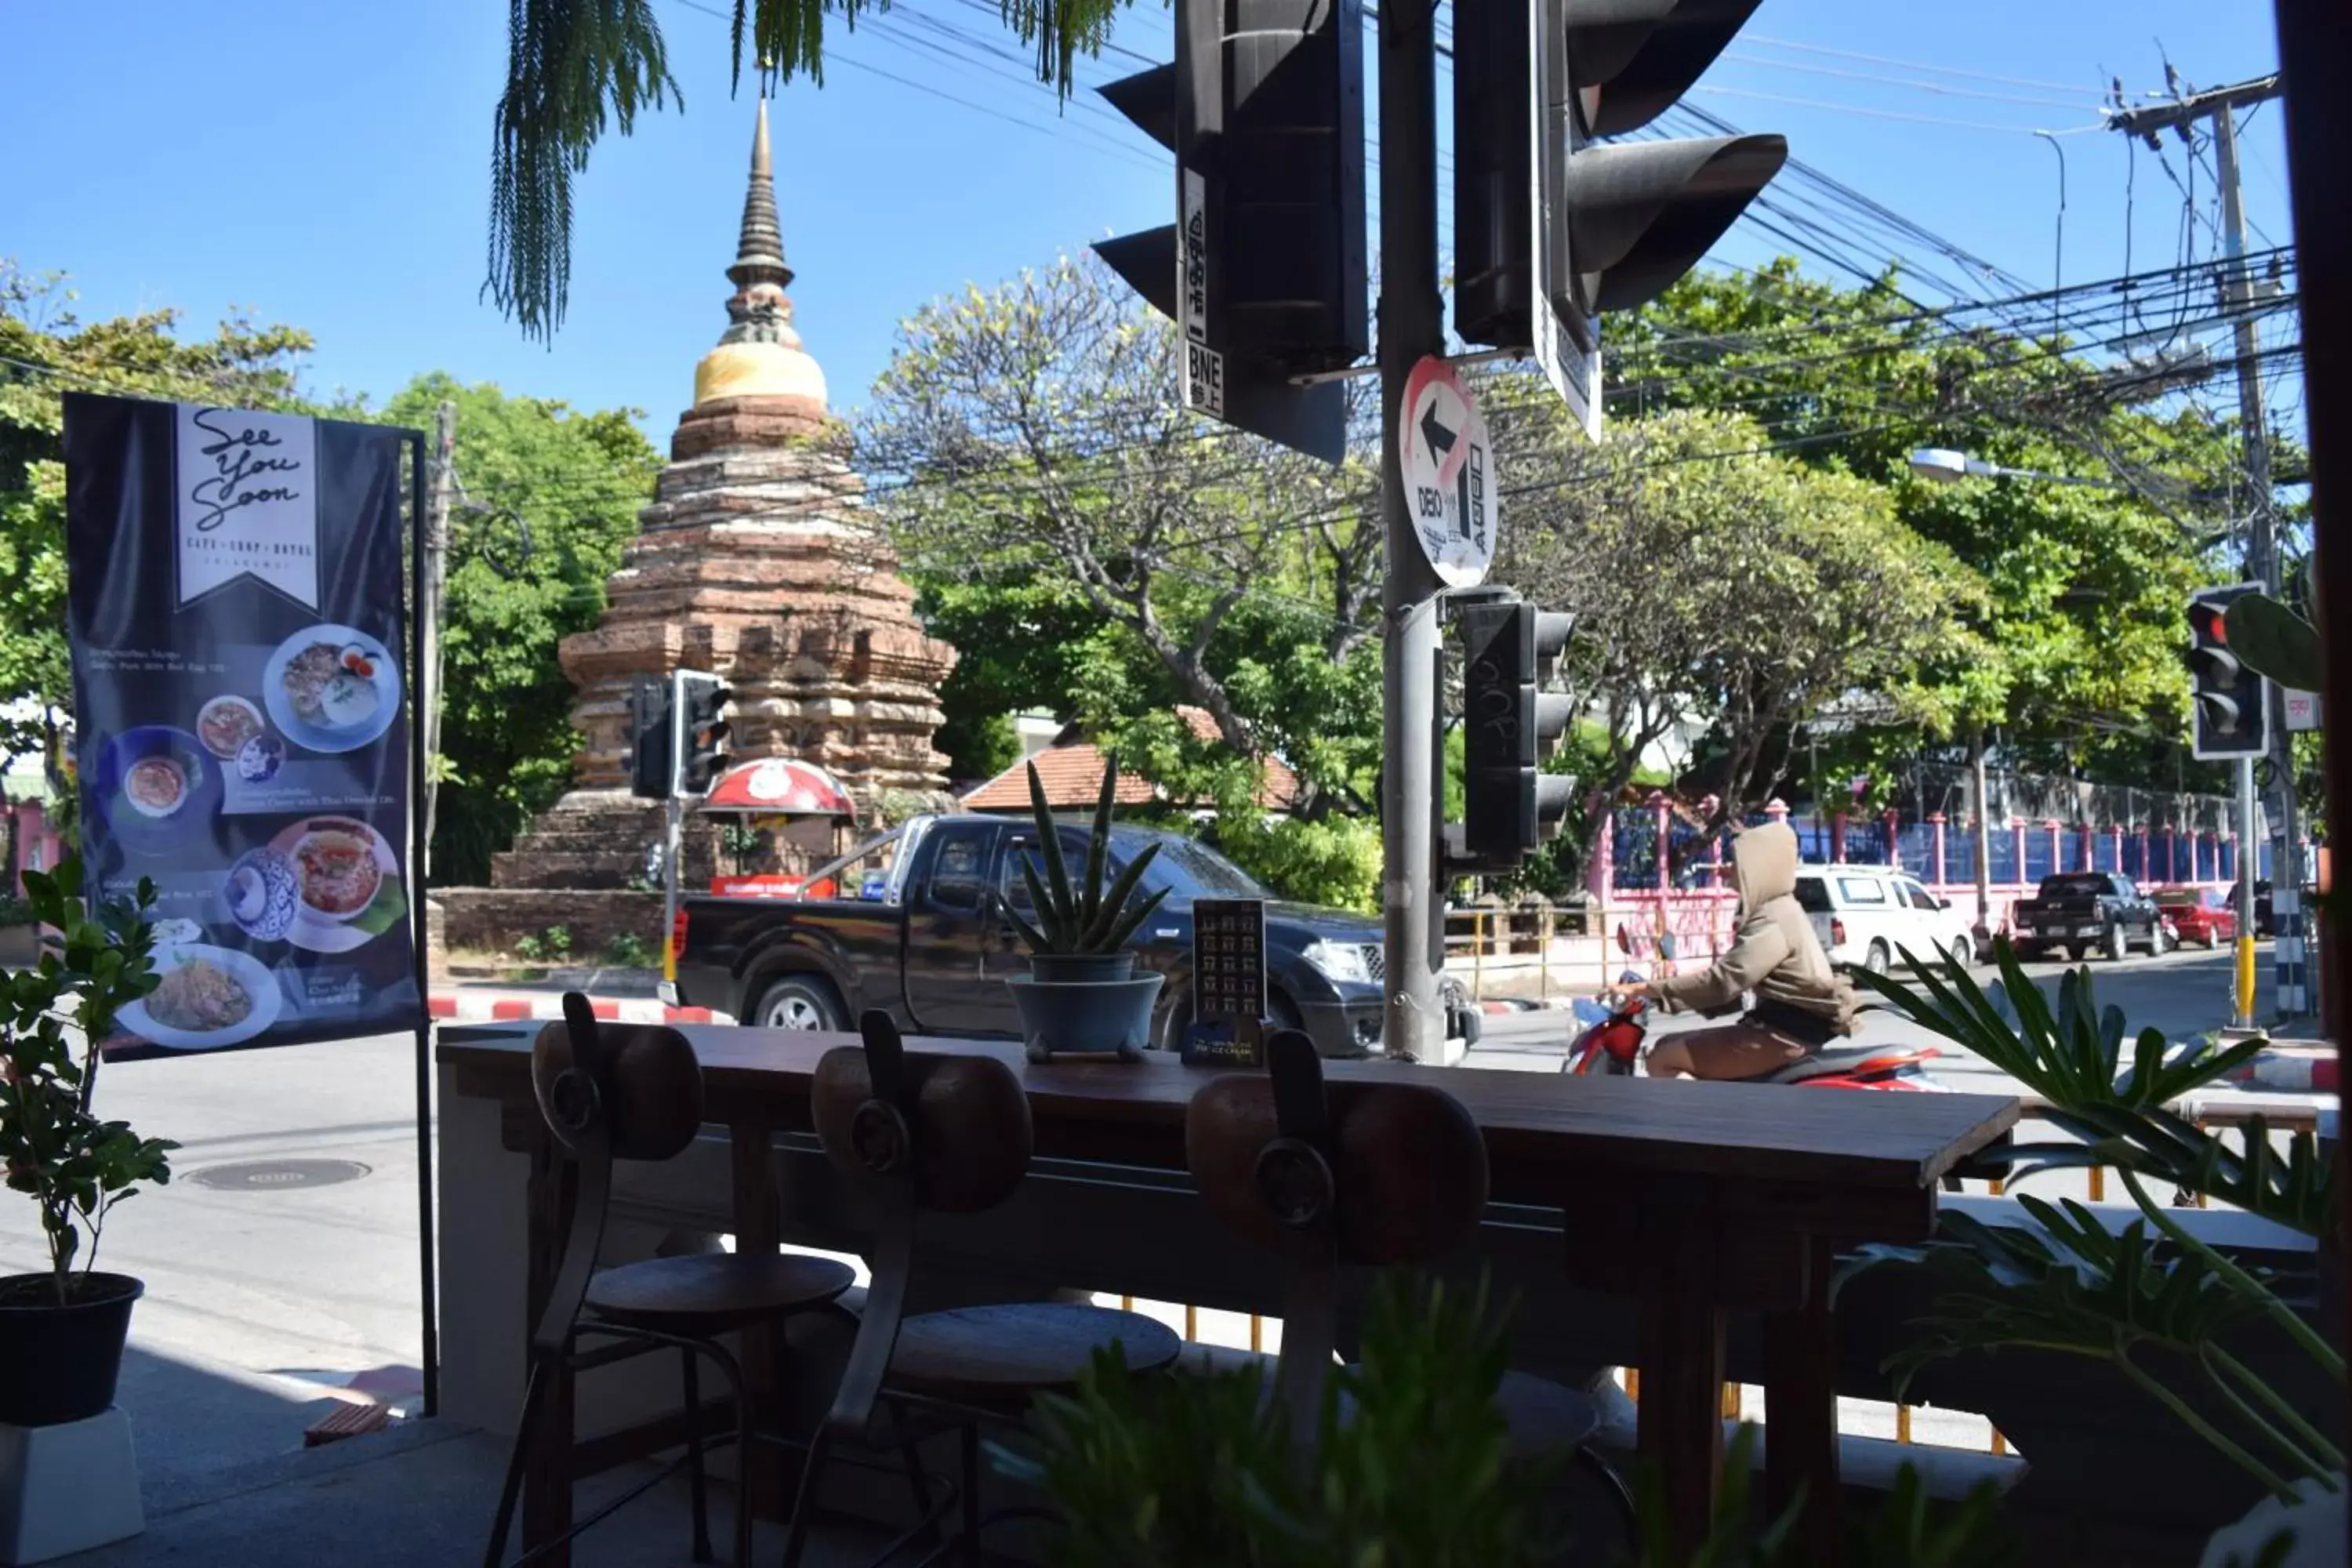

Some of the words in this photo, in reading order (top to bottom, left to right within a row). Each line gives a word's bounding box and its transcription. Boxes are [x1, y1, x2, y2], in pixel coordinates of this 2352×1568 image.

[1189, 345, 1220, 389] BNE
[193, 407, 282, 455] See
[216, 449, 300, 501] You
[191, 477, 299, 532] Soon
